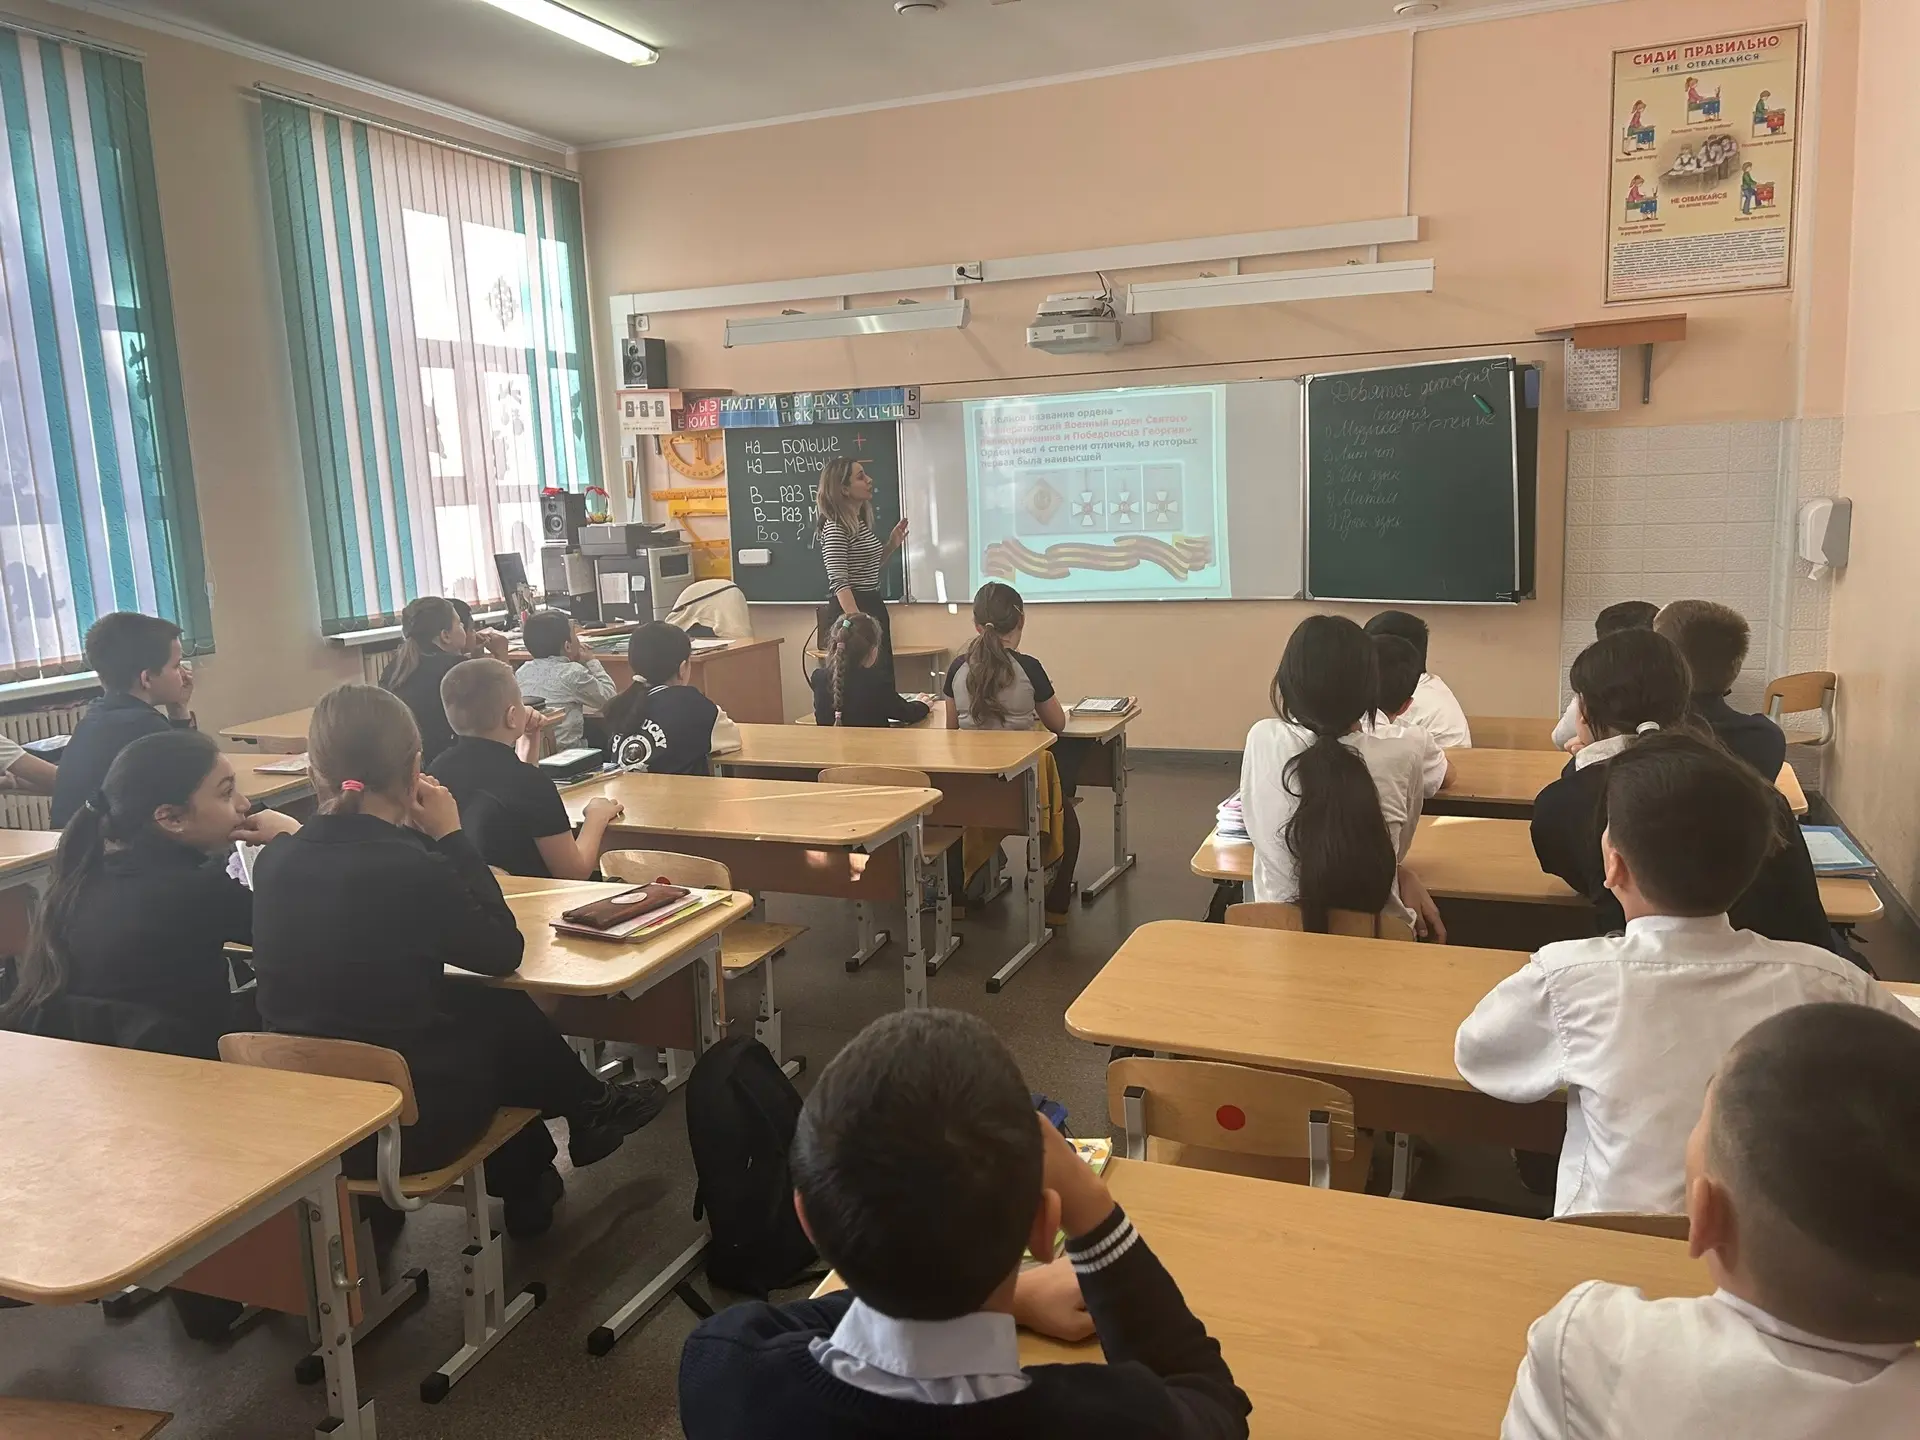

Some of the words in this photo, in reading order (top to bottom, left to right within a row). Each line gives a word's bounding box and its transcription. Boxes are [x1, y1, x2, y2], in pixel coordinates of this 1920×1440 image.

[1633, 50, 1677, 65] СИДИ
[1685, 35, 1780, 58] ПРАВИЛЬНО
[1666, 64, 1679, 72] НЕ
[1687, 53, 1760, 69] ОТВЛЕКАЙСЯ
[1078, 407, 1114, 419] ордена
[1064, 418, 1110, 430] Военный
[1112, 416, 1143, 428] орден
[1145, 414, 1189, 425] Святого
[1072, 427, 1140, 441] Победоносца
[980, 447, 1011, 459] Орден
[1012, 446, 1038, 456] имел
[1039, 445, 1046, 453] 4
[1048, 443, 1088, 455] степени
[1090, 440, 1135, 450] отличия,
[1137, 439, 1151, 448] из
[1152, 437, 1199, 448] которых
[1017, 455, 1043, 466] была
[1045, 452, 1102, 464] наивысшей
